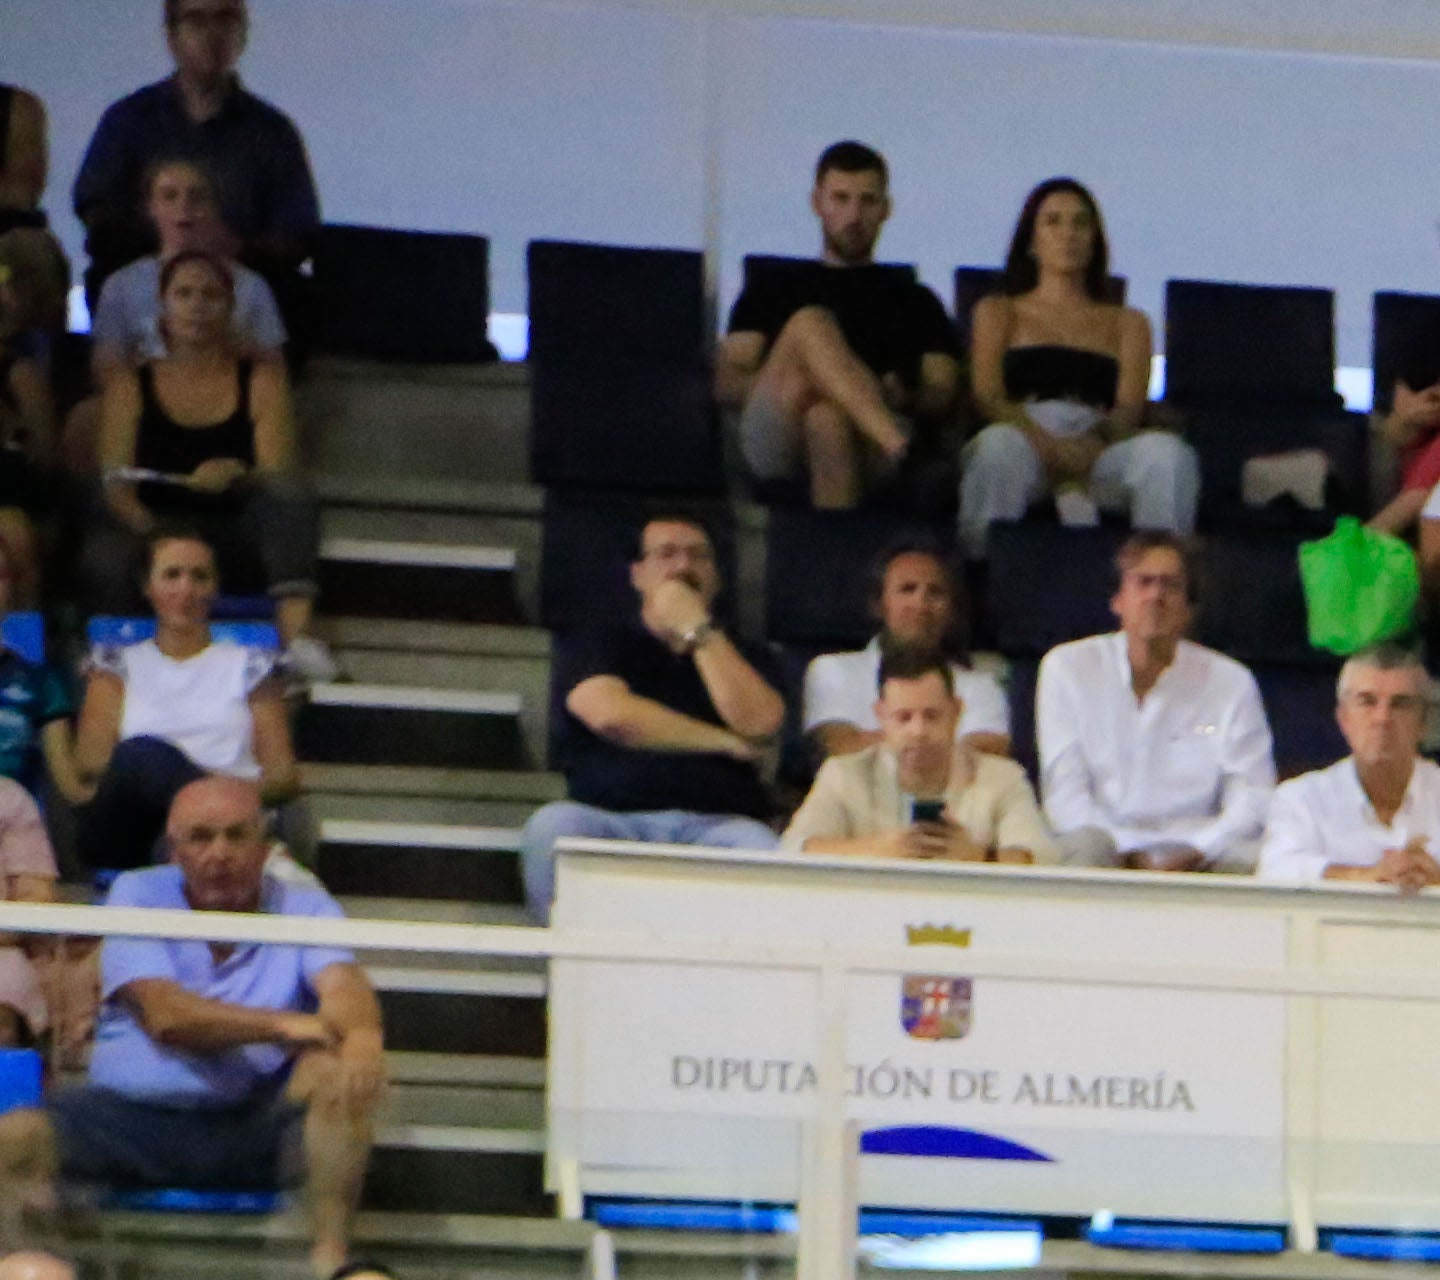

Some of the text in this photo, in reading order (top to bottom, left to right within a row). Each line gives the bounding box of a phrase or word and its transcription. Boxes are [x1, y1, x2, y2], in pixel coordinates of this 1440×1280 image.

[671, 1055, 1197, 1113] DIPUTAIÓN DE ALMERÍA
